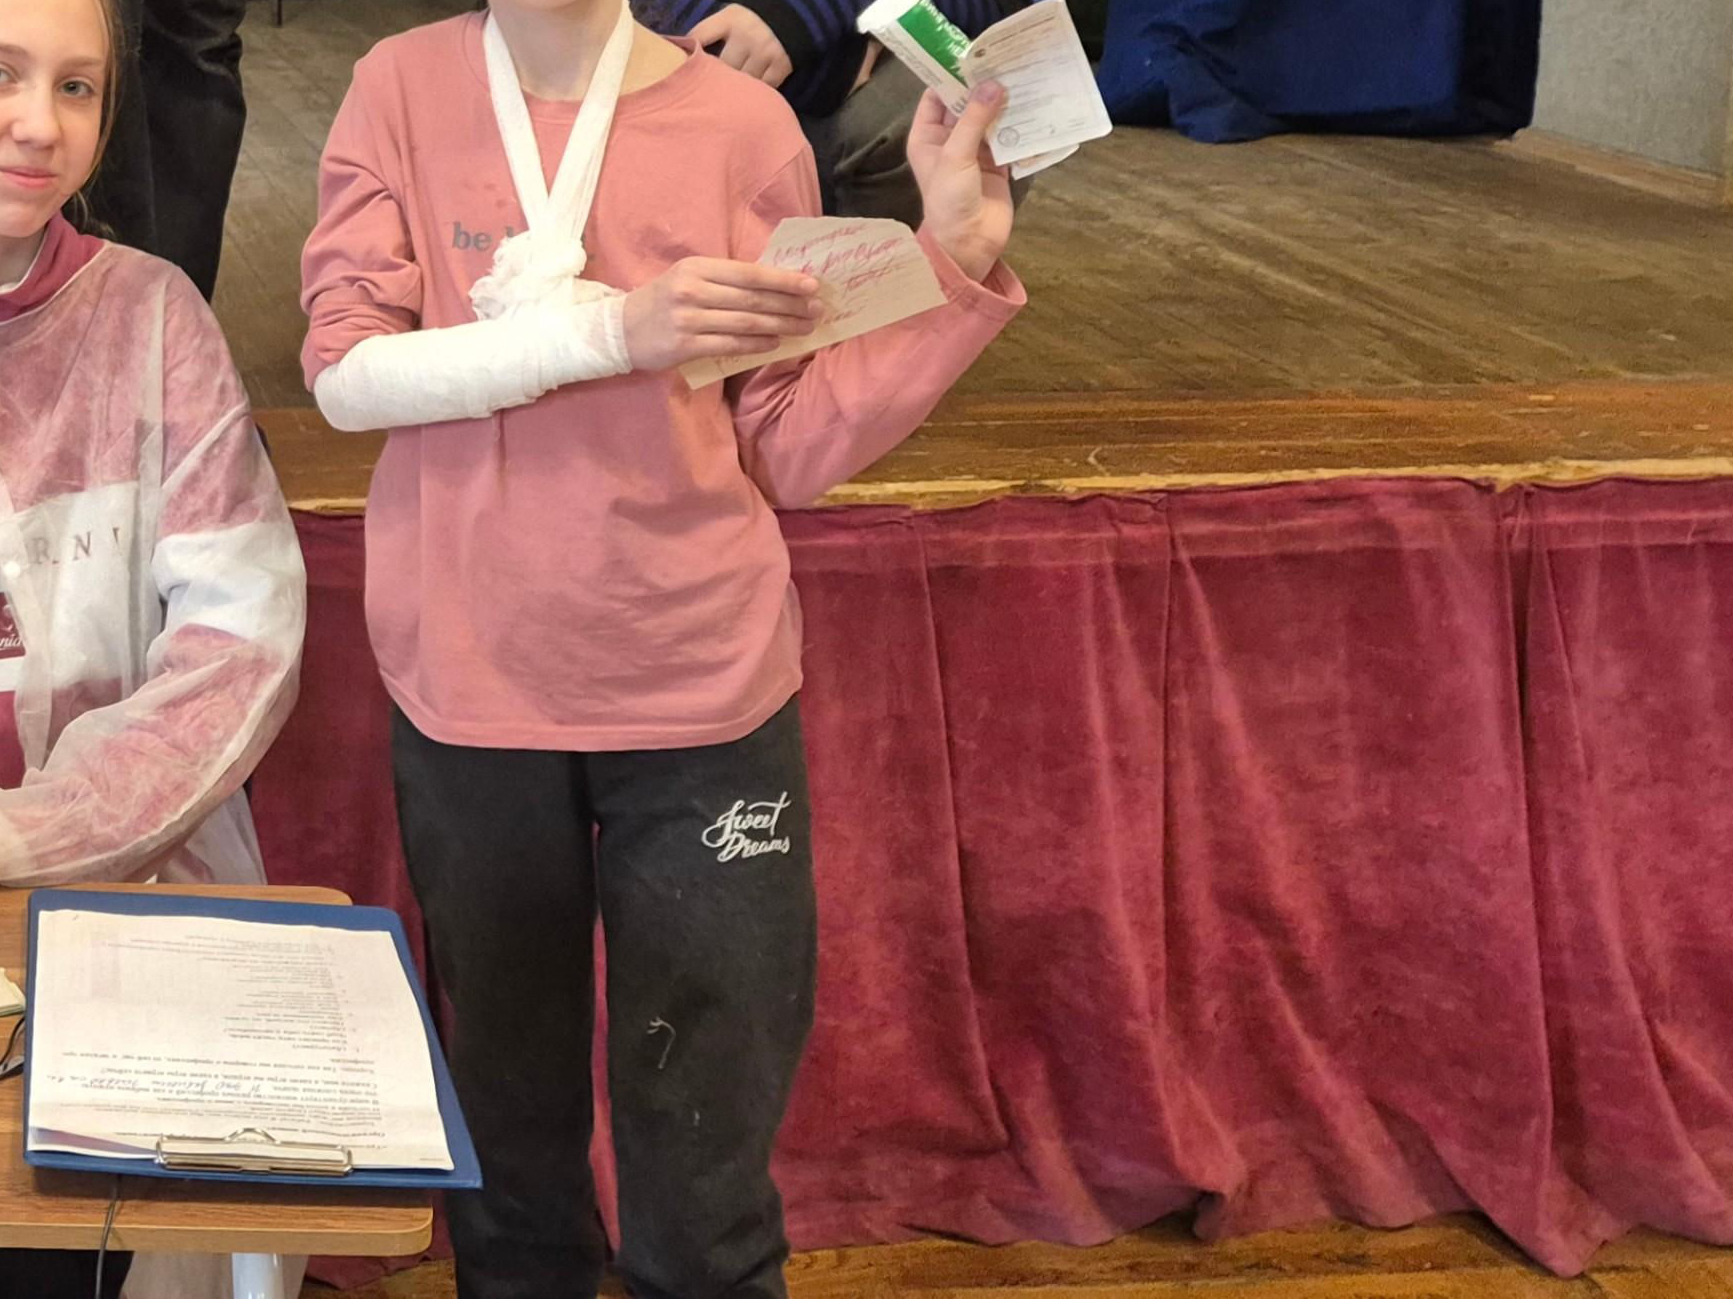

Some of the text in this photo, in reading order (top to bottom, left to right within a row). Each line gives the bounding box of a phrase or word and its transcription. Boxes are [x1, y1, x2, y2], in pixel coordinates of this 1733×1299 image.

[452, 221, 492, 252] be
[701, 790, 792, 848] Sweet
[717, 831, 791, 863] Dreams
